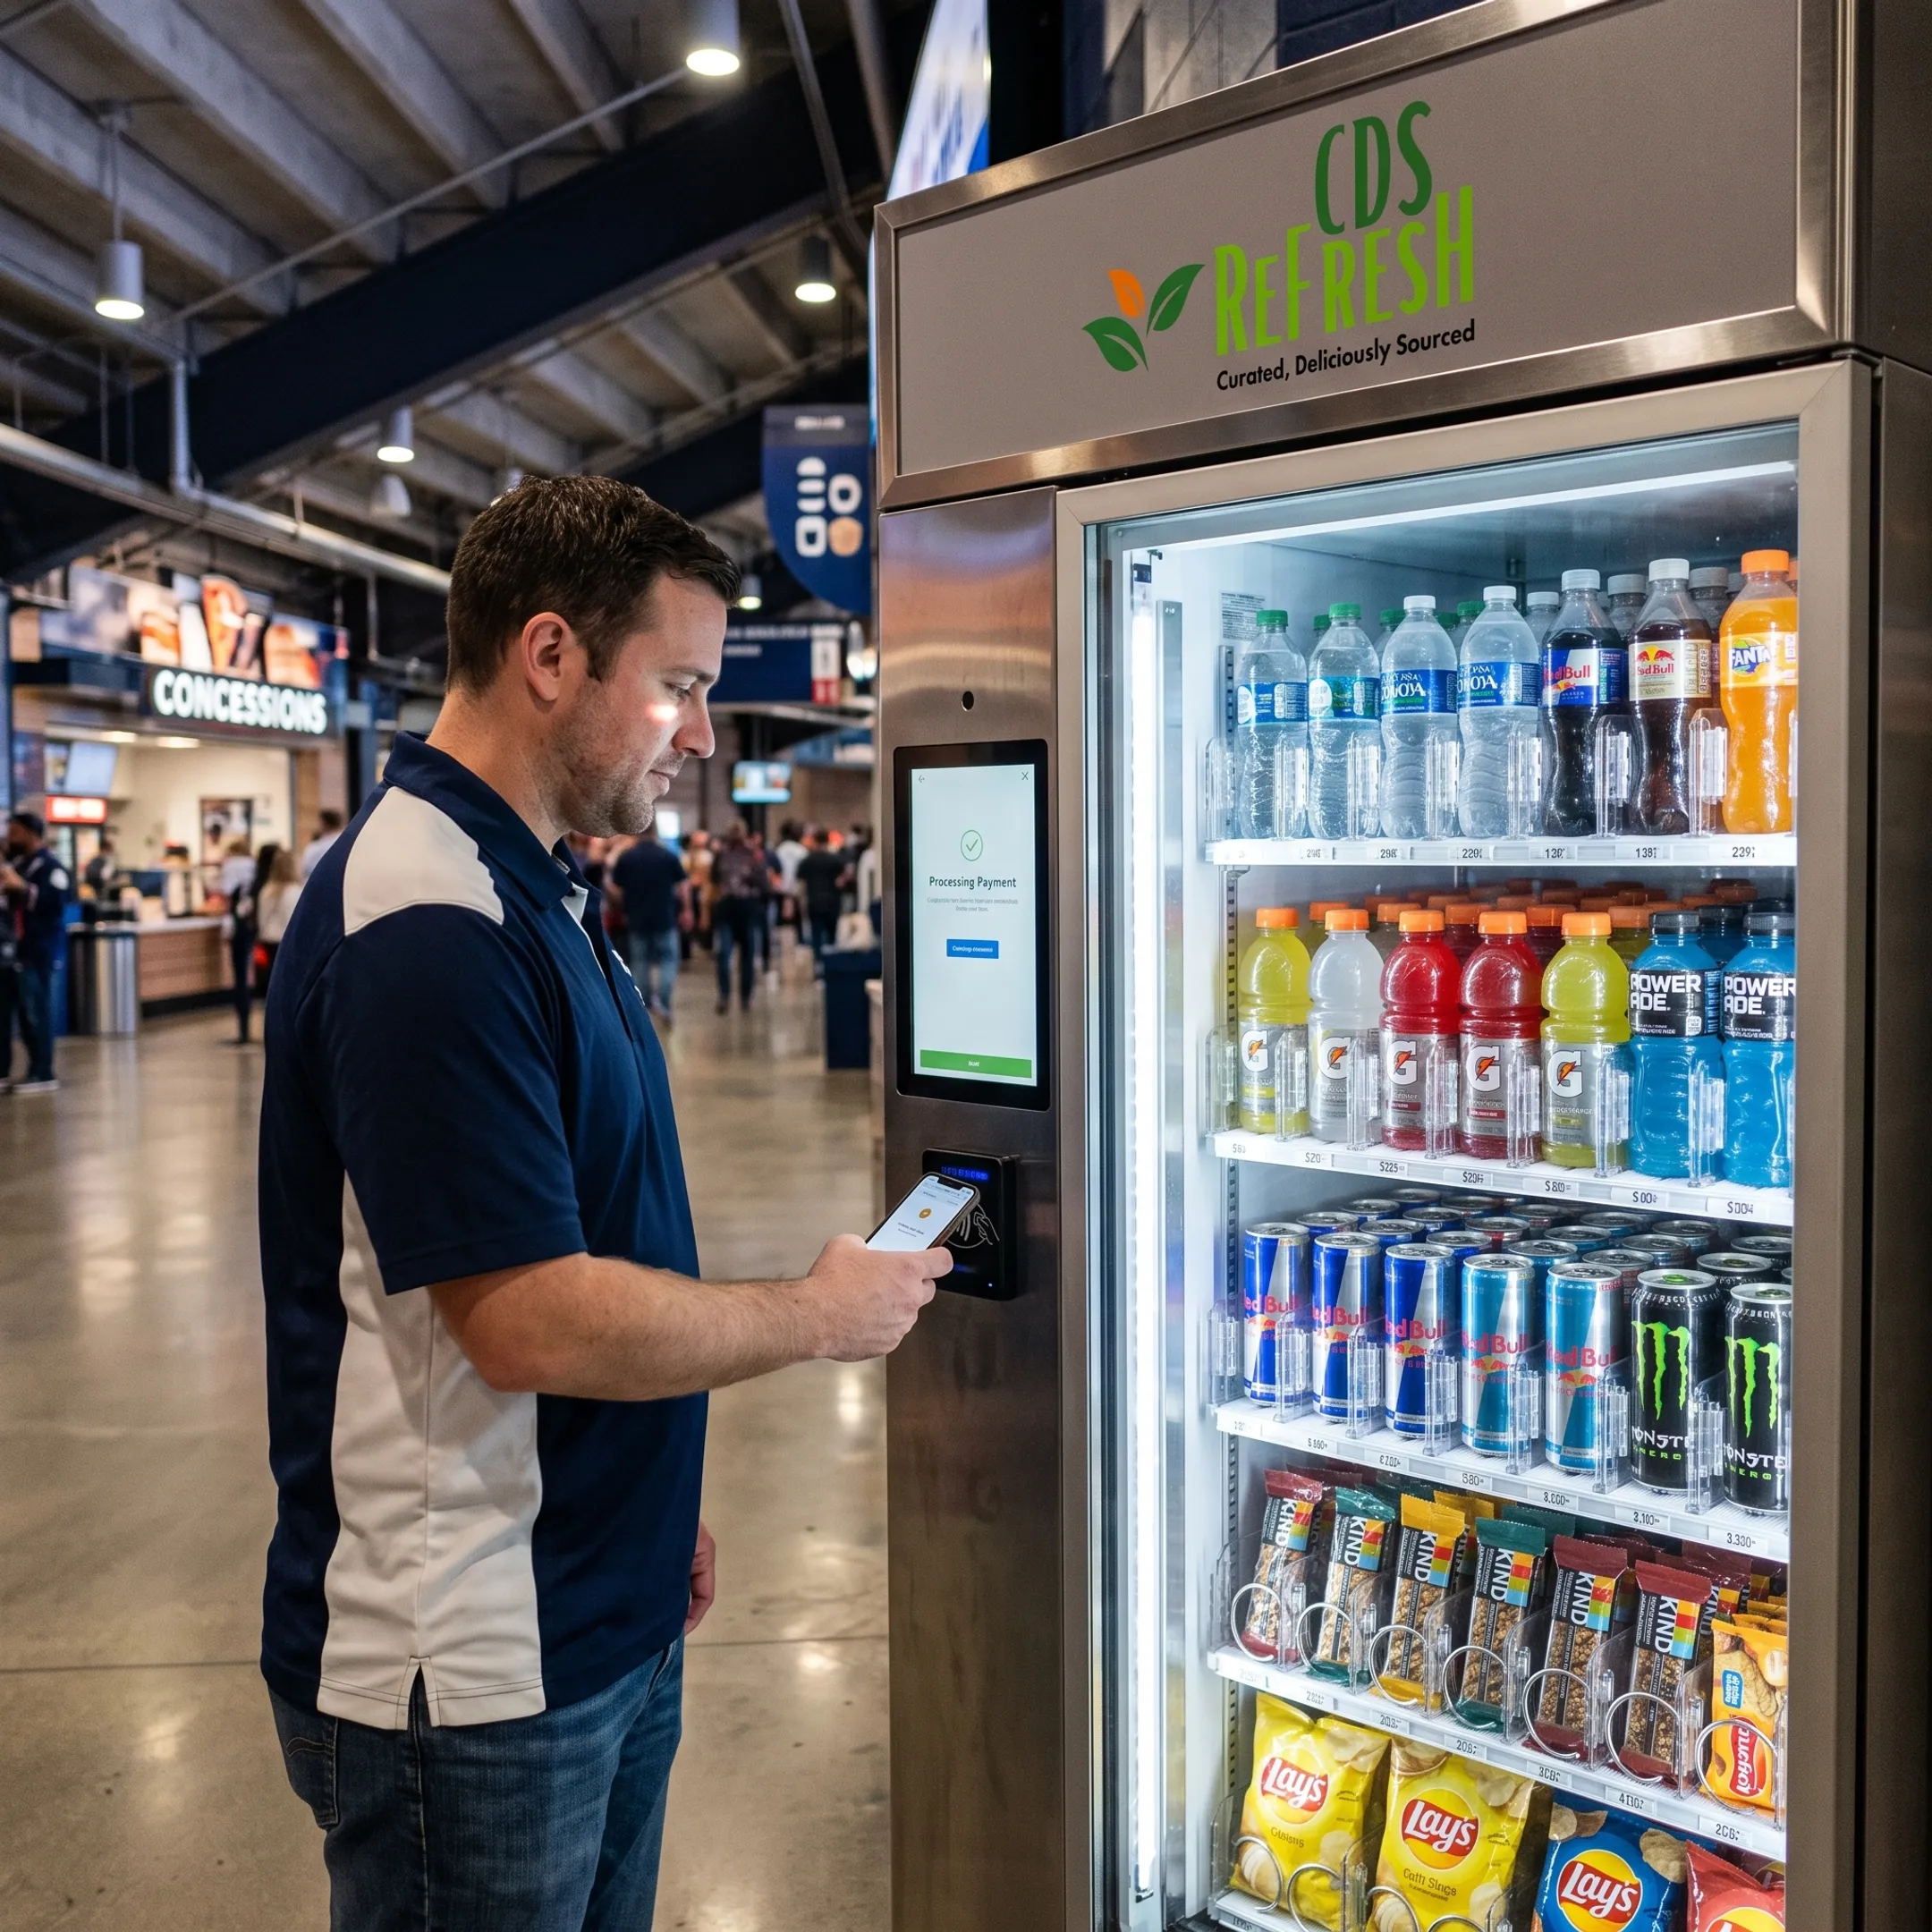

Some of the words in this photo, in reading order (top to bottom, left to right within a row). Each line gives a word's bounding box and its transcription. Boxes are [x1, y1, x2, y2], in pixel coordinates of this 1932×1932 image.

[1315, 100, 1432, 235] CDS
[1214, 185, 1474, 356] REFRESH
[1216, 359, 1290, 391] Curated,
[1295, 339, 1391, 377] Deliciously
[1396, 318, 1475, 355] Sourced
[1564, 665, 1590, 679] Bull
[1655, 663, 1674, 674] Bull
[153, 669, 327, 734] CONCESSIONS
[929, 876, 975, 890] Processing
[977, 876, 1017, 891] Payment
[1724, 976, 1796, 997] POWER
[1241, 1030, 1268, 1072] G
[1386, 1040, 1418, 1086] G
[1466, 1045, 1501, 1092] G
[1547, 1050, 1583, 1098] G
[1410, 1319, 1446, 1340] Bull
[1492, 1335, 1529, 1354] Bull
[1724, 1443, 1787, 1470] ONSTE
[1275, 1498, 1298, 1546] KIND
[1343, 1515, 1369, 1566] KIND
[1414, 1530, 1438, 1582] KIND
[1490, 1548, 1514, 1601] KIND
[1571, 1571, 1596, 1626] KIND
[1654, 1595, 1679, 1653] KIND
[1262, 1758, 1327, 1809] Lay's
[1403, 1799, 1479, 1854] Lay's
[1561, 1862, 1639, 1919] Lay's
